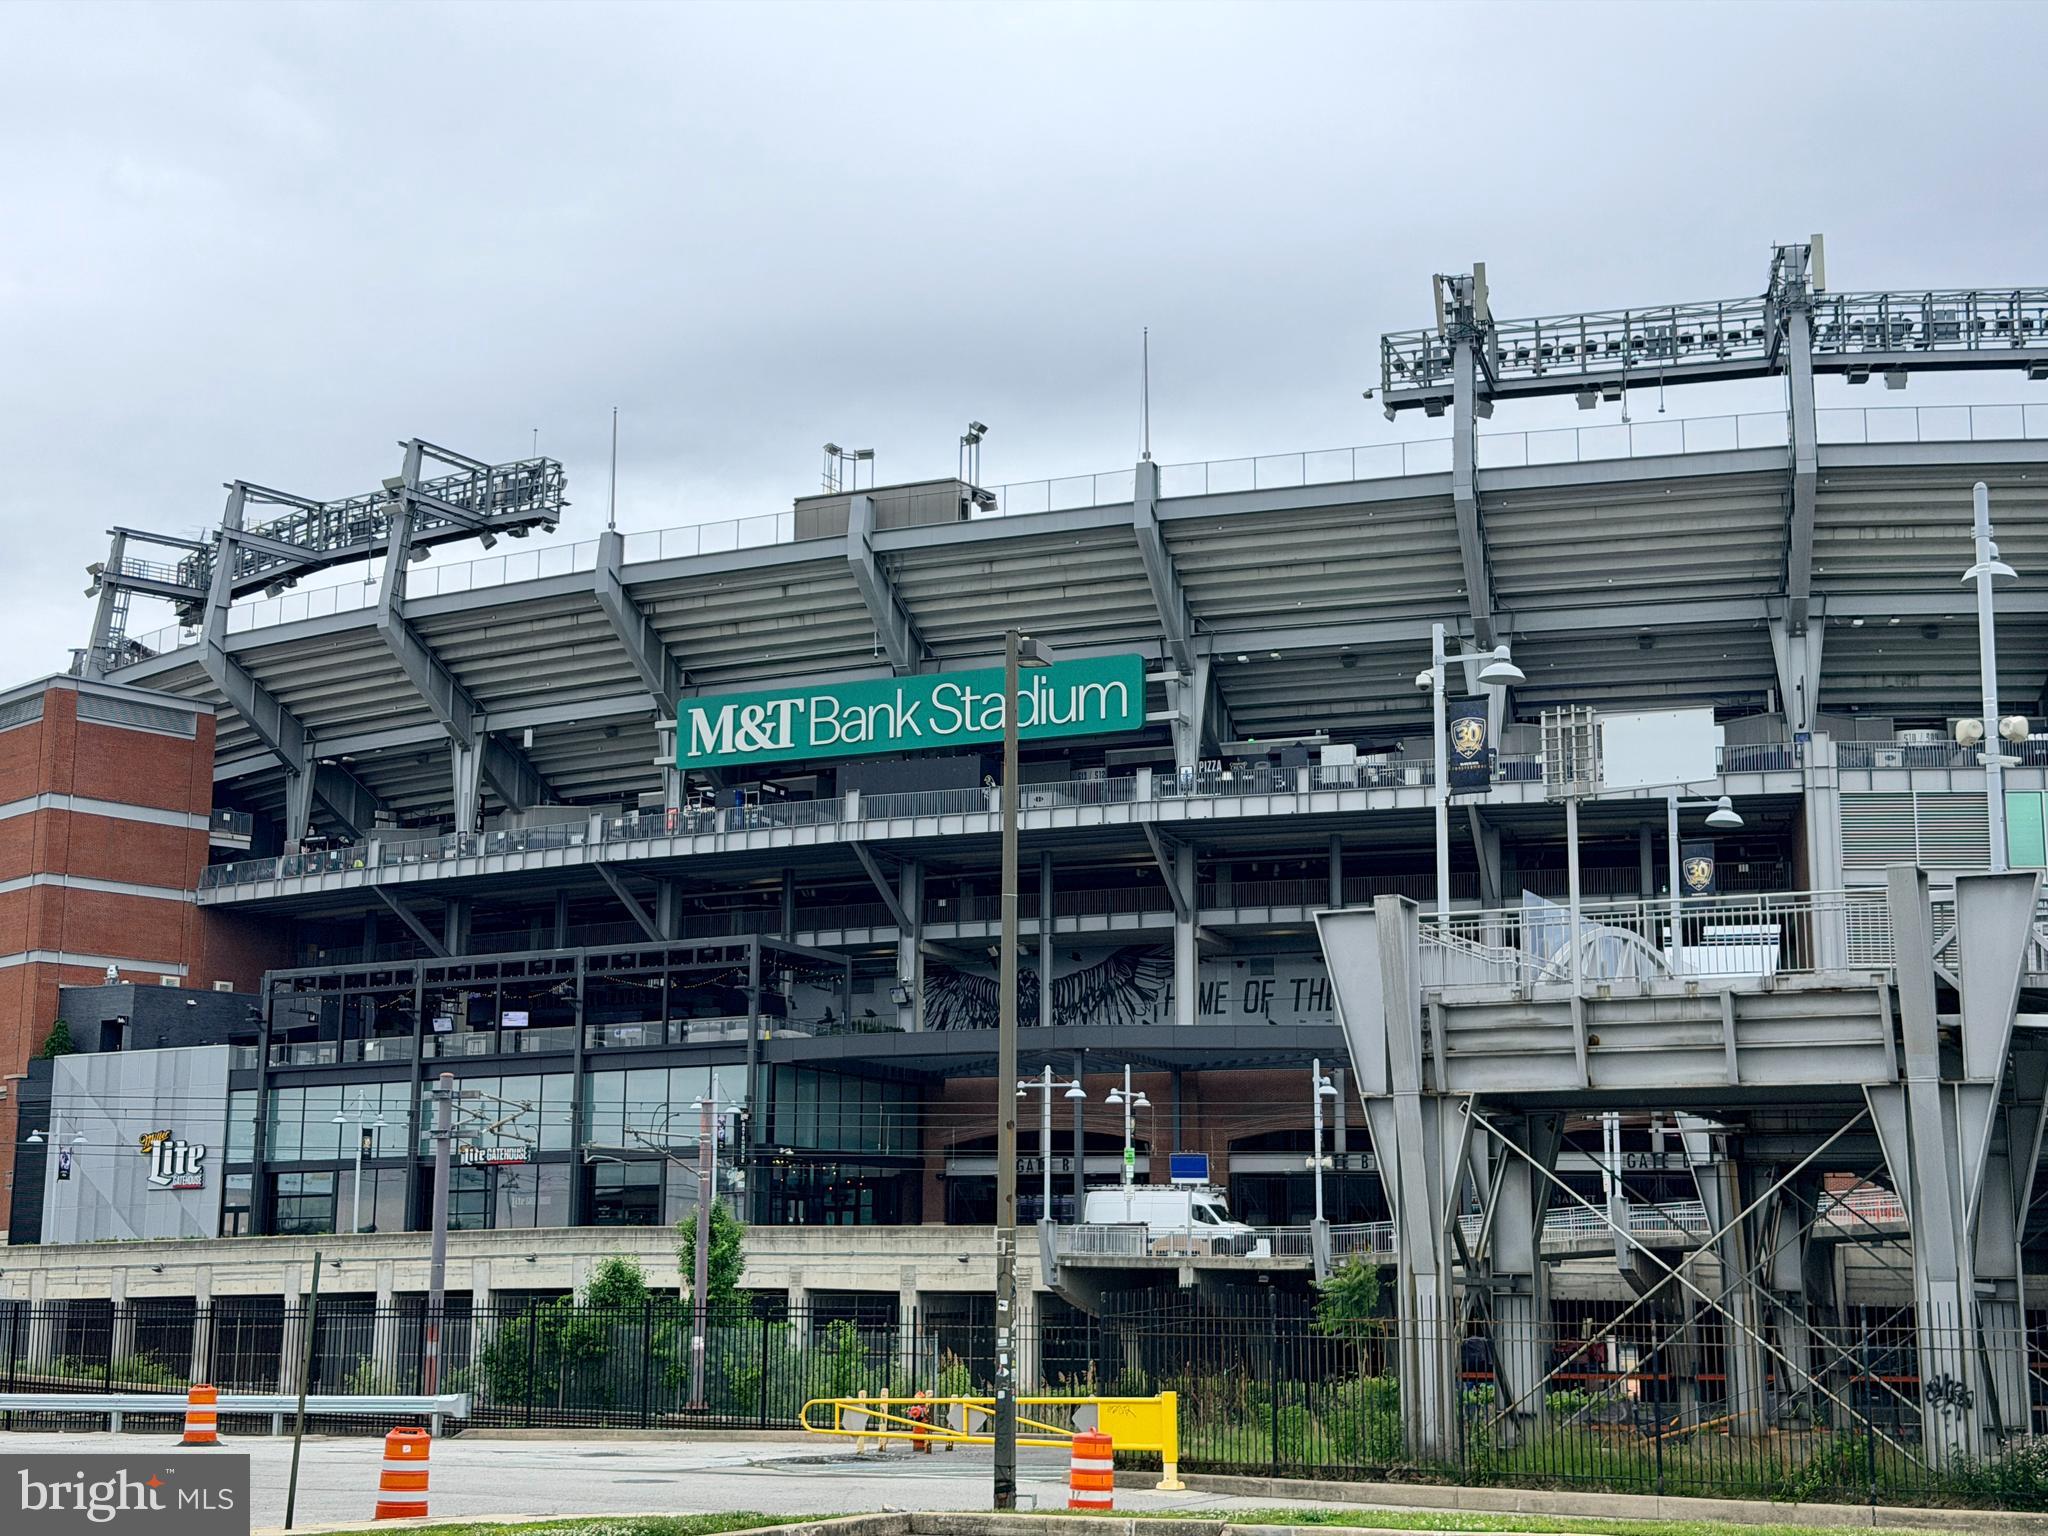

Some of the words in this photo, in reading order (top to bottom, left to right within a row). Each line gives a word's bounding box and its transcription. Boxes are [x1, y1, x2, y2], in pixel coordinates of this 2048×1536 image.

[687, 698, 804, 757] M&T
[809, 688, 923, 746] Bank
[929, 674, 1128, 735] Stadium
[1456, 723, 1482, 742] 30
[1199, 759, 1222, 773] PIZZA
[1687, 863, 1708, 877] 30
[1164, 981, 1229, 1017] HME
[1243, 979, 1276, 1014] OF
[140, 1130, 172, 1153] Miller
[148, 1140, 204, 1186] Lite
[464, 1148, 485, 1165] Lite
[486, 1147, 528, 1161] GATEHOUSE
[1062, 1158, 1070, 1171] B
[1361, 1154, 1369, 1169] B
[1627, 1153, 1669, 1168] GATE
